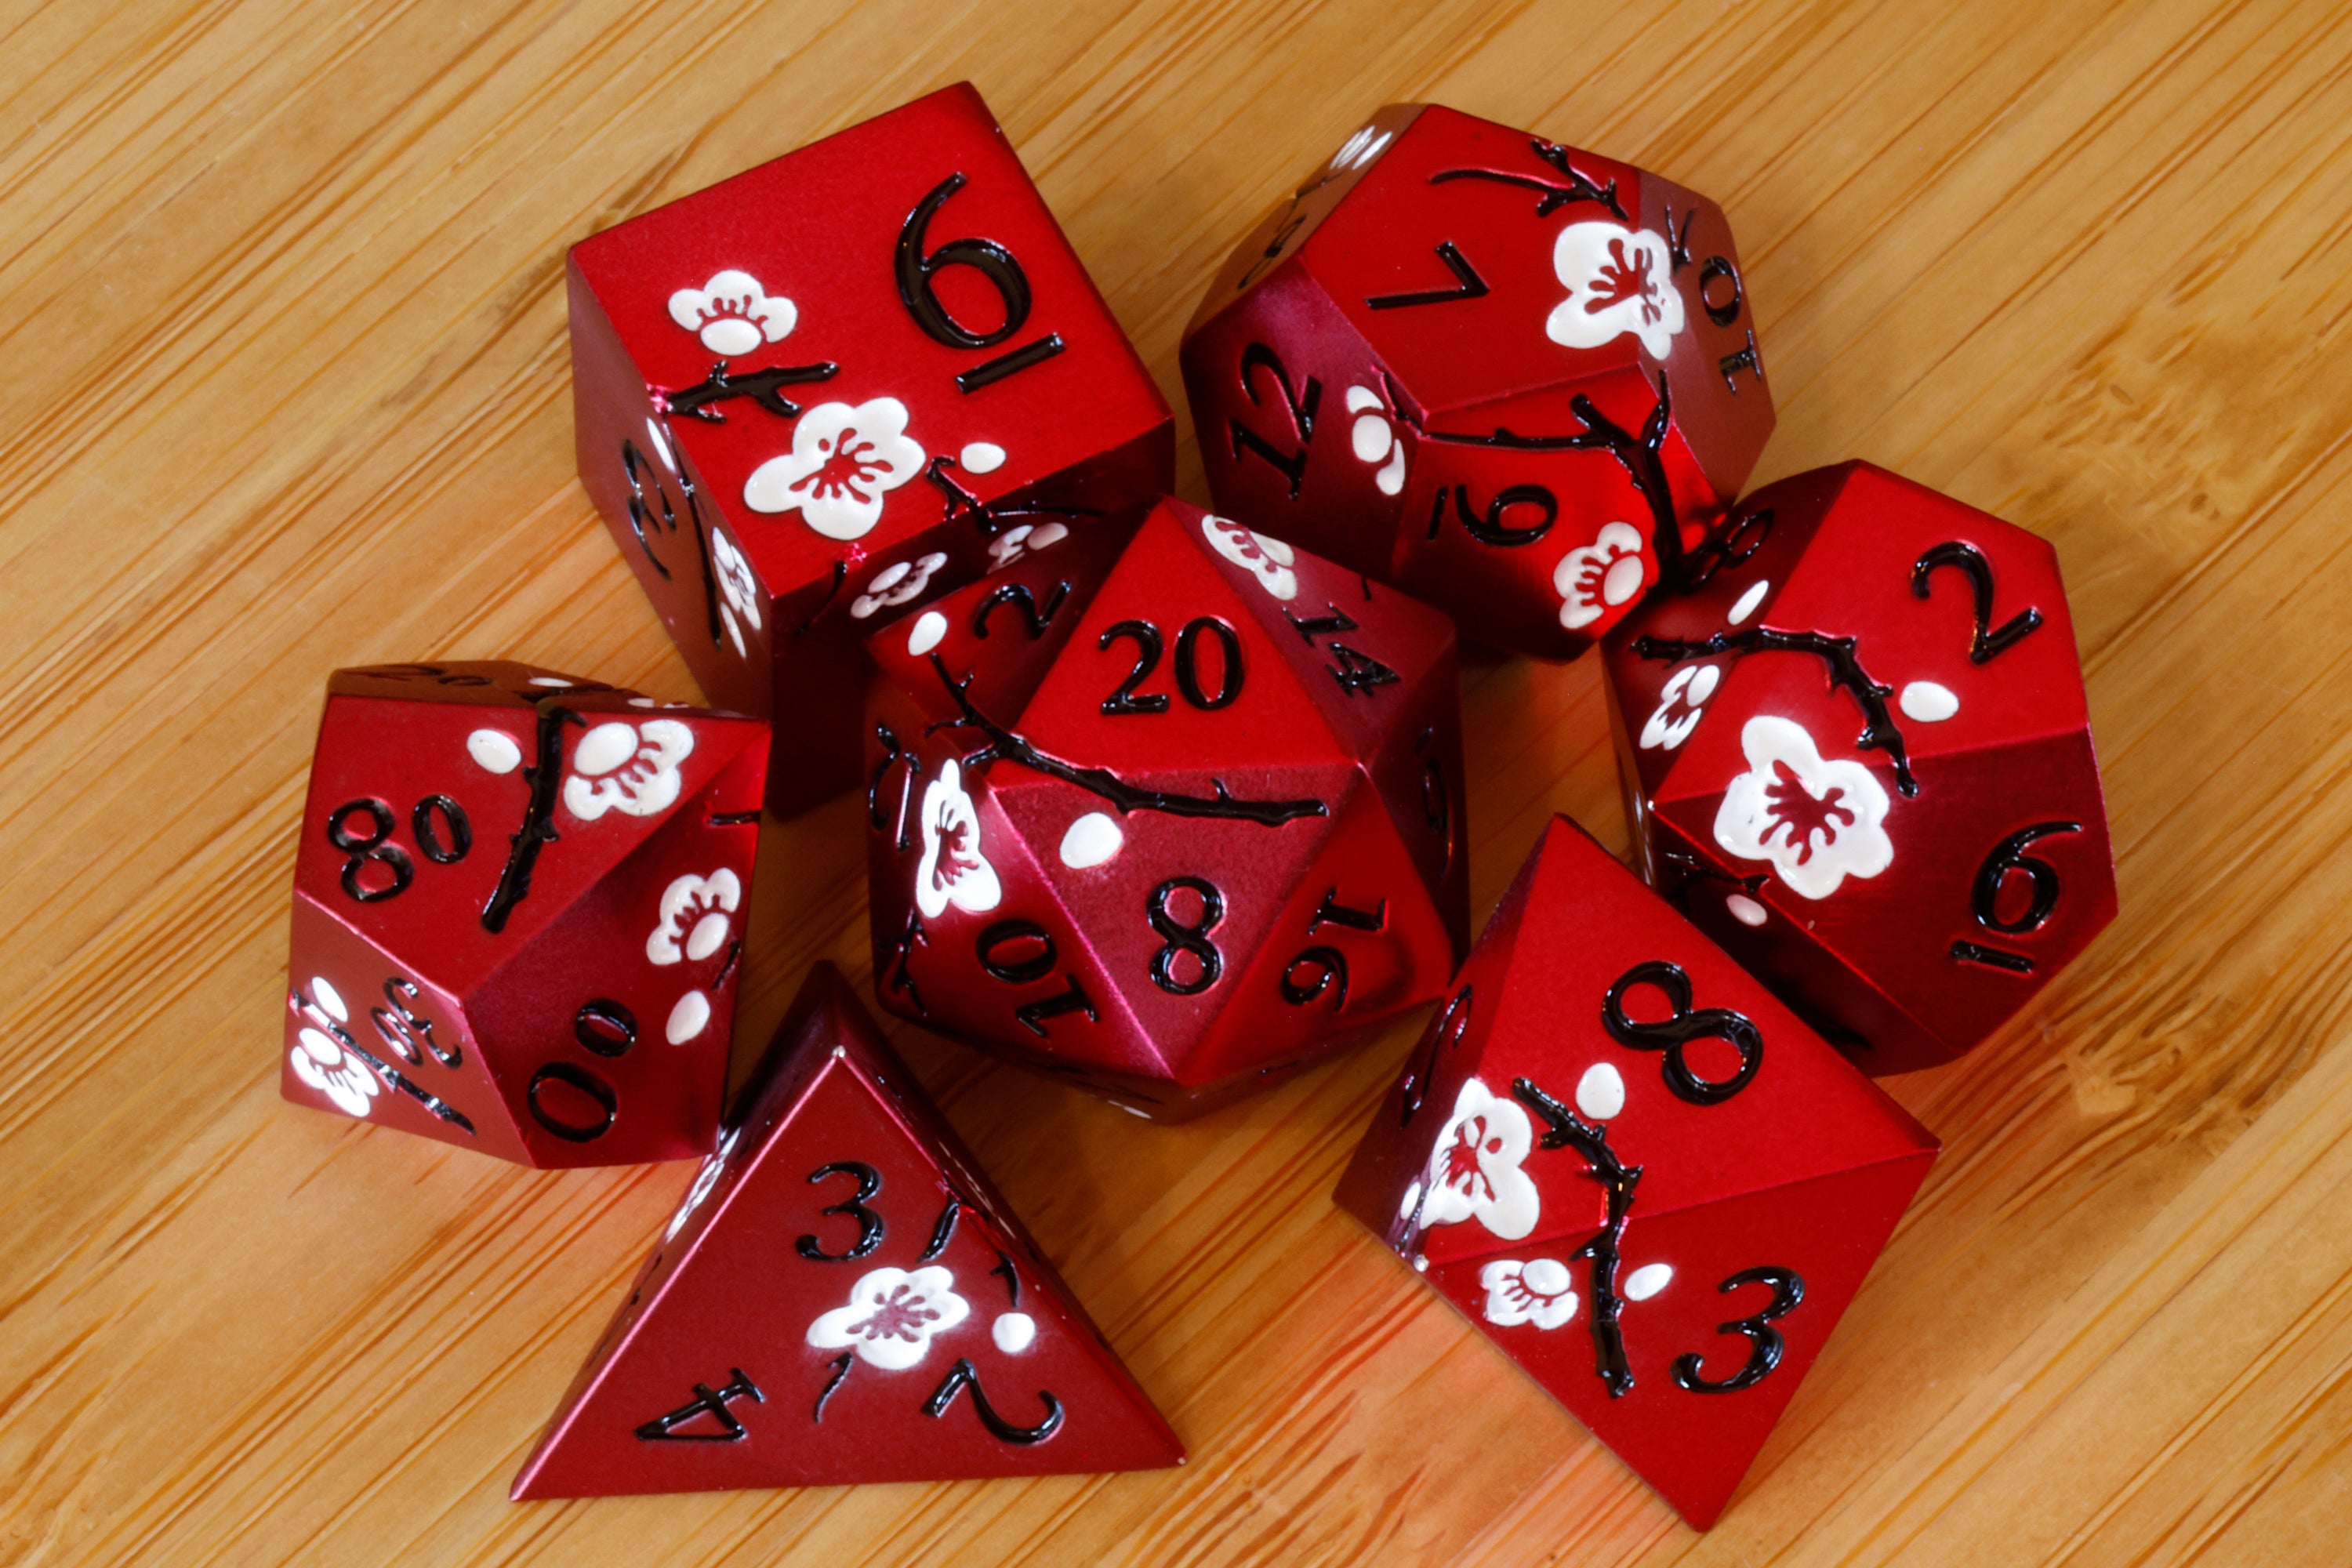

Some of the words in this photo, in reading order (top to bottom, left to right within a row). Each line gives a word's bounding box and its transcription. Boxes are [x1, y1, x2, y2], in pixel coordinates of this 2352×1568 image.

[894, 172, 1065, 394] 6
[1363, 241, 1490, 310] 7
[1699, 256, 1762, 397] 10
[1228, 342, 1323, 500] 12
[972, 580, 1073, 640] 2
[1281, 601, 1402, 698] 14
[1910, 540, 2043, 665] 2
[1098, 616, 1245, 715] 20
[327, 794, 472, 903] 80
[975, 918, 1098, 1038] 10
[1145, 877, 1229, 996] 8
[528, 997, 638, 1143] 00
[1602, 960, 1764, 1105] 8
[795, 1161, 884, 1261] 3
[1669, 1265, 1806, 1394] 3
[633, 1367, 767, 1443] 4
[921, 1357, 1065, 1446] 2
